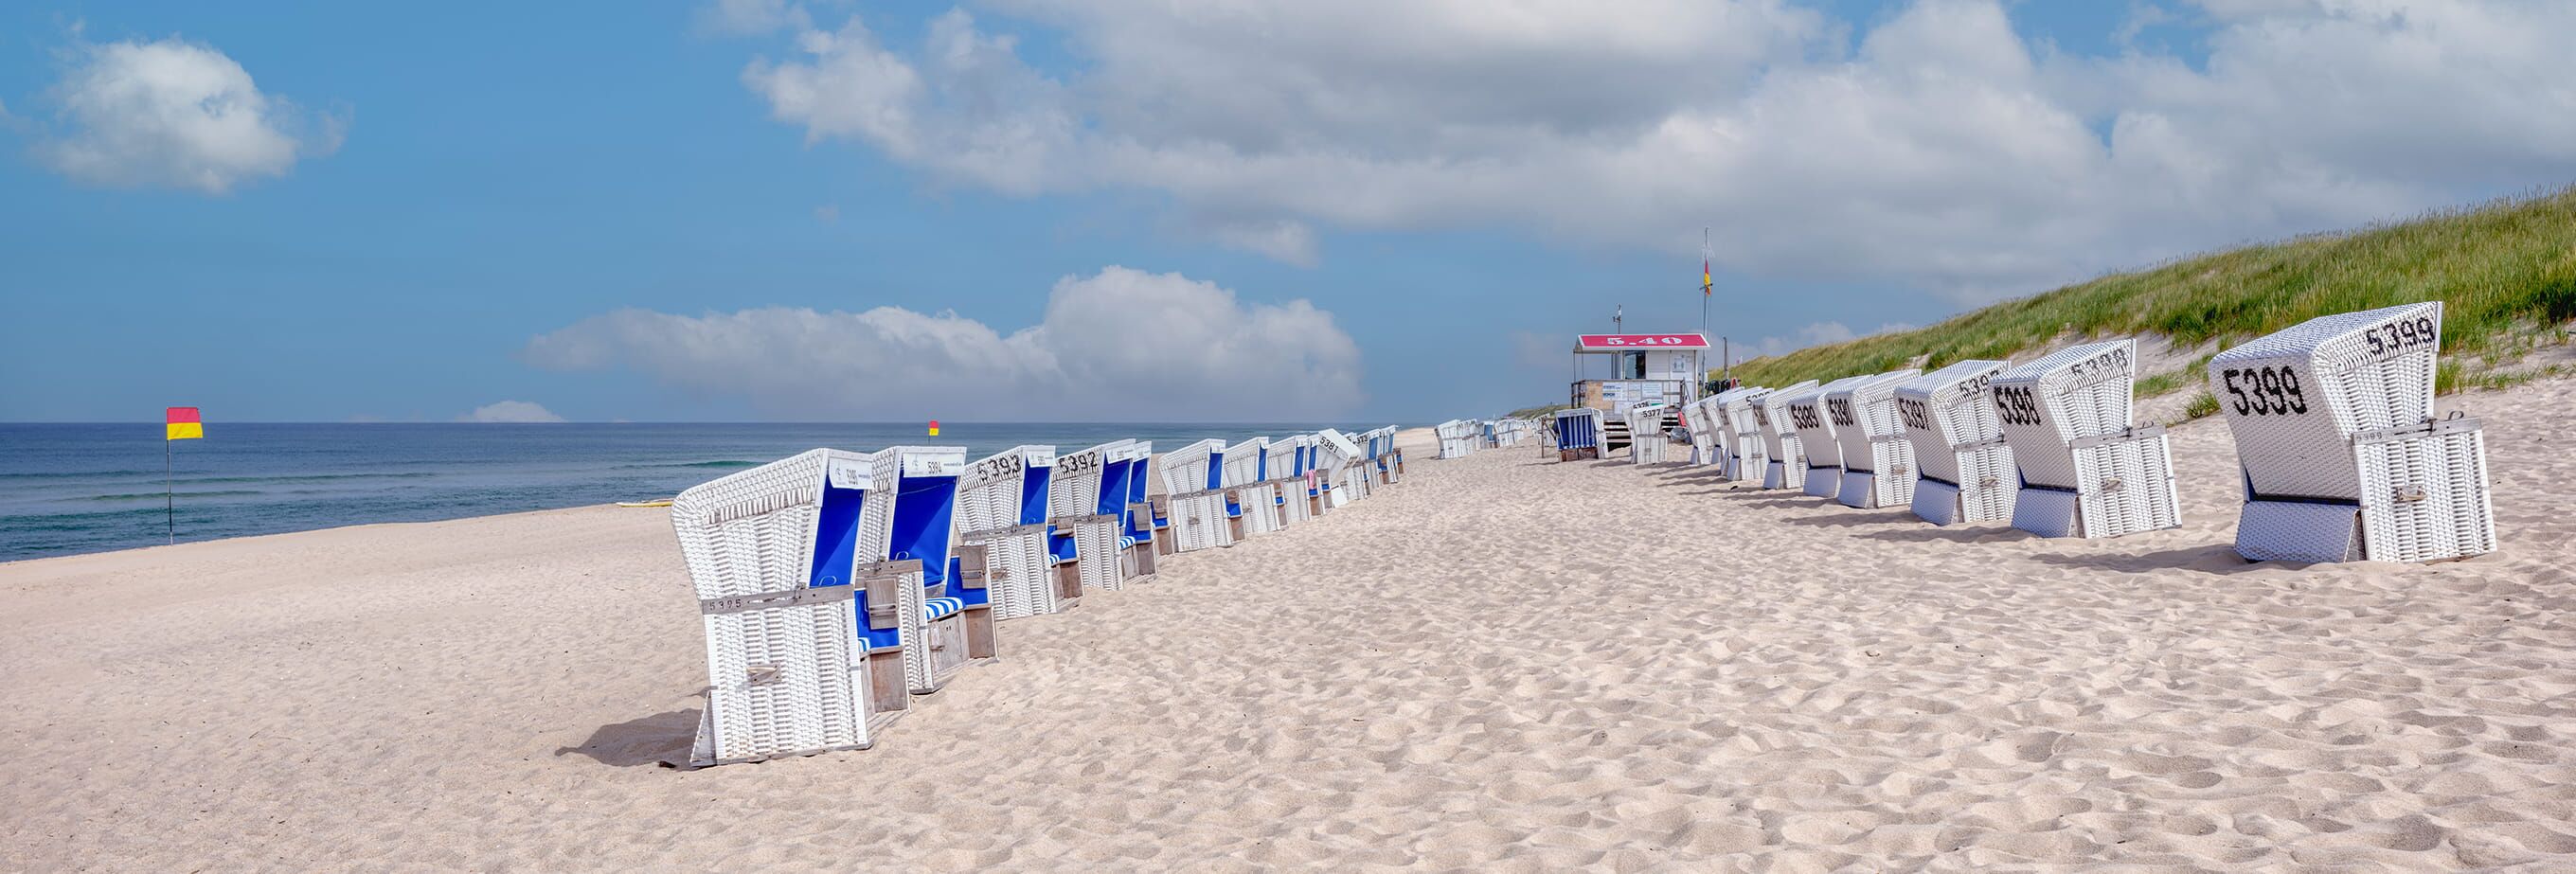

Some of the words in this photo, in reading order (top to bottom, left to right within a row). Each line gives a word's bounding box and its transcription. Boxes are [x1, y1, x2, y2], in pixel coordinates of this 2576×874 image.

[2367, 317, 2435, 355] 5399
[2223, 366, 2307, 416] 5399
[1643, 409, 1661, 418] 5377
[1791, 404, 1819, 429] 5389
[1828, 399, 1853, 426] 5390
[1898, 398, 1930, 431] 5397
[1994, 385, 2041, 425] 5398
[1319, 437, 1339, 454] 5381
[977, 455, 1022, 481] 5393
[1059, 452, 1098, 473] 5392
